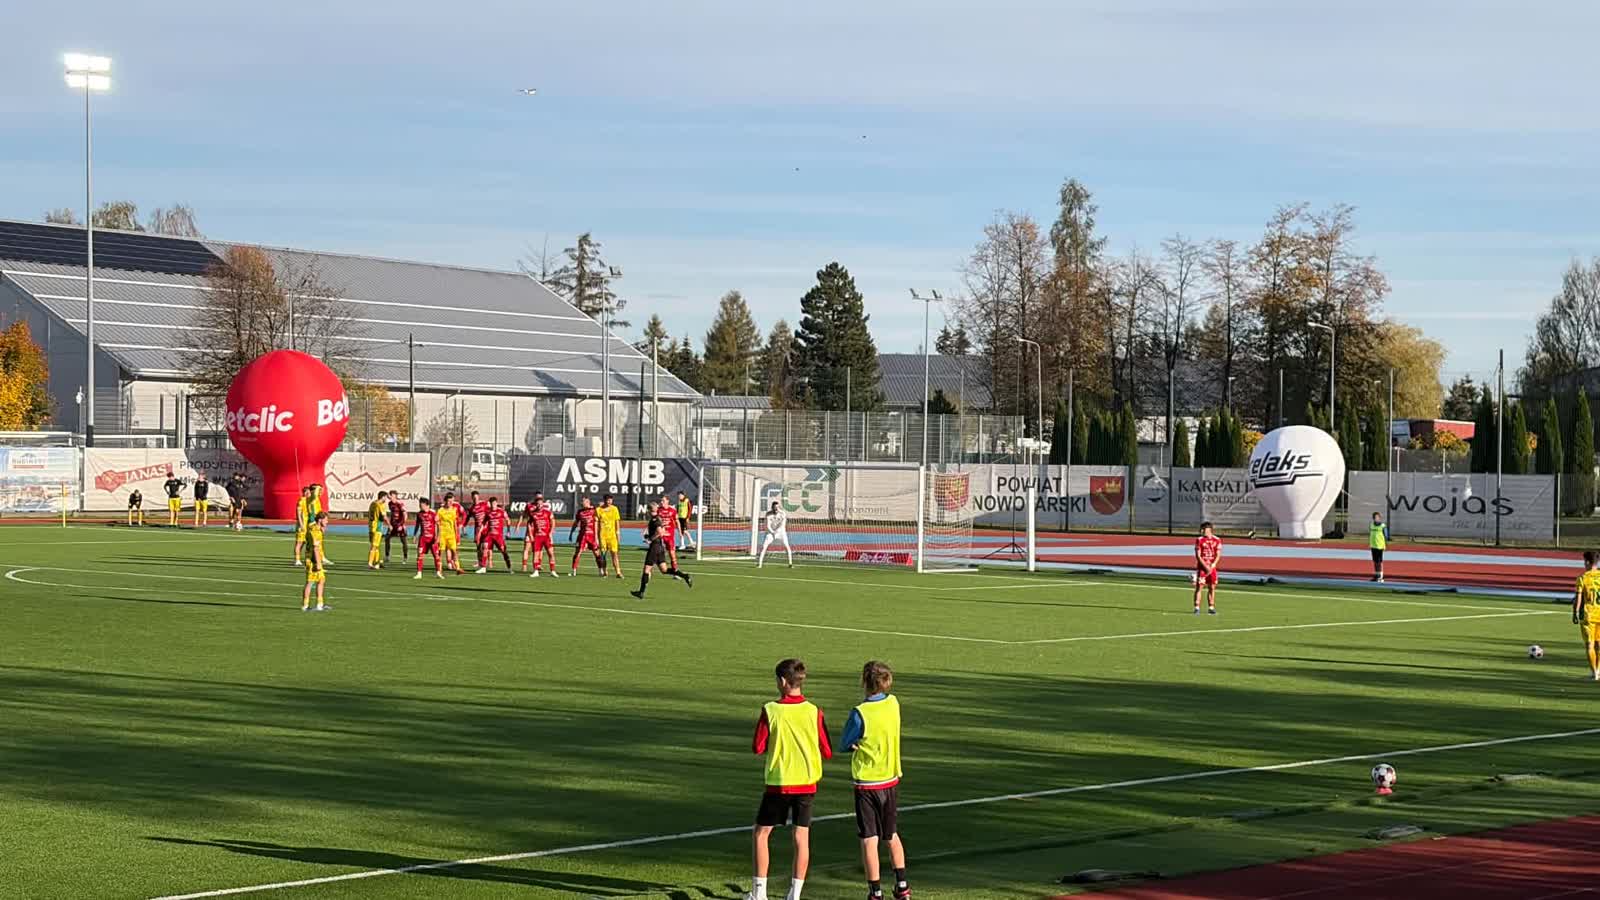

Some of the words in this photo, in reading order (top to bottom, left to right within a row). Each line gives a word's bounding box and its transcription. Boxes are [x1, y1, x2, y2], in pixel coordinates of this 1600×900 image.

[225, 404, 294, 433] etclic
[556, 457, 665, 485] ASMB
[556, 484, 600, 494] AUTO
[609, 485, 665, 495] GROUP
[997, 477, 1062, 493] POWIAT
[510, 499, 565, 513] KRÓW
[973, 494, 1087, 513] NOWOARSKI
[1386, 487, 1515, 516] wojas
